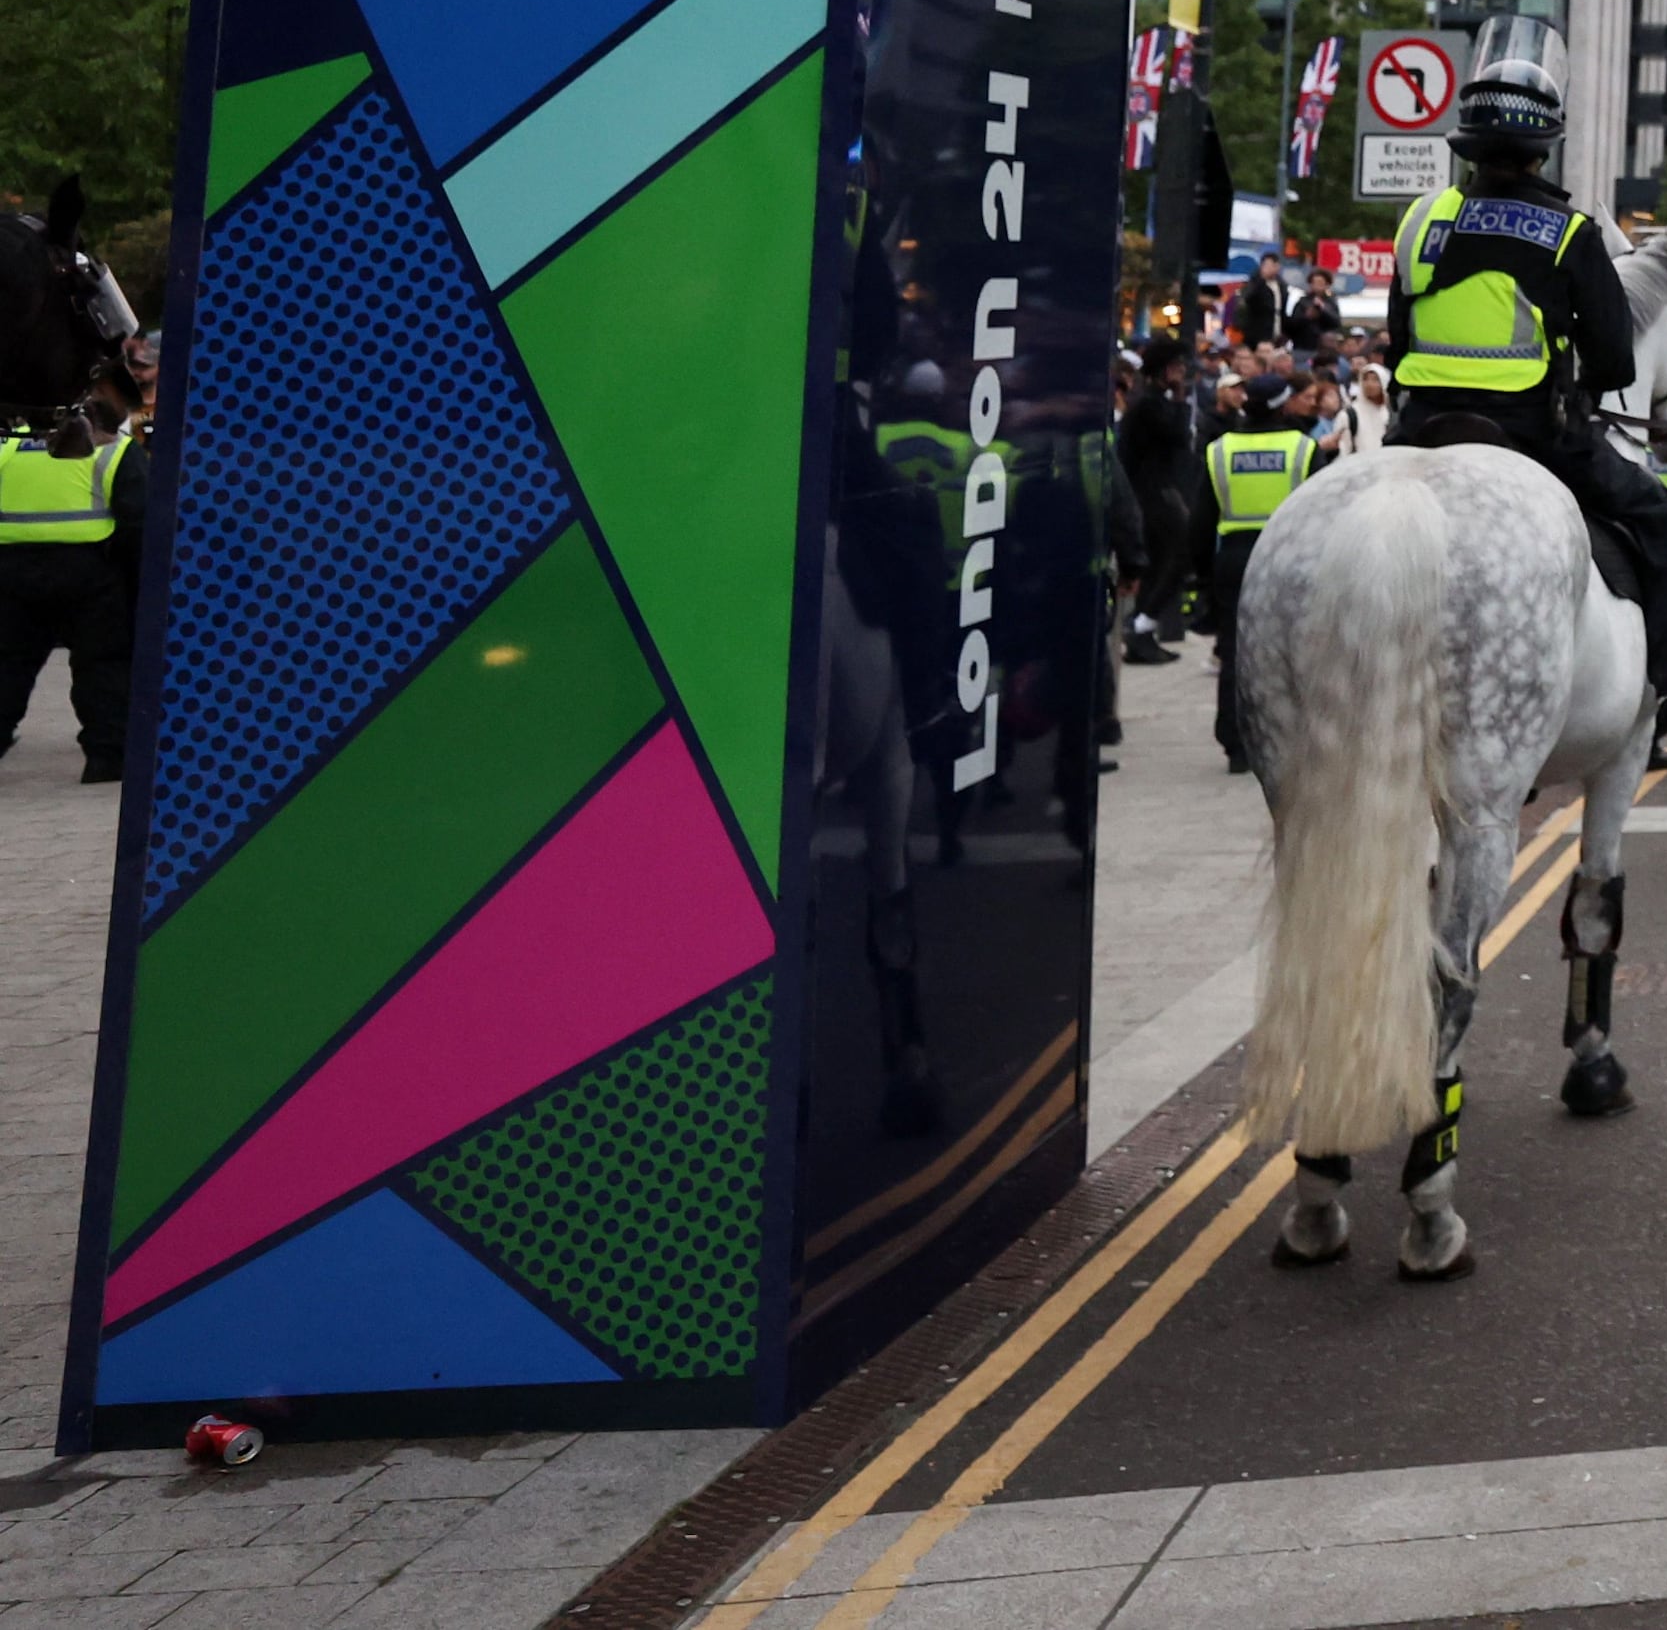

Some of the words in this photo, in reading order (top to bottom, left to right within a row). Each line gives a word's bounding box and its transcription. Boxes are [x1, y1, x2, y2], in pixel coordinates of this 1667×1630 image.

[982, 71, 1030, 241] 24
[1384, 142, 1433, 157] Except
[1378, 158, 1436, 171] vehicles
[1370, 174, 1410, 188] under
[1463, 212, 1557, 246] POLICE
